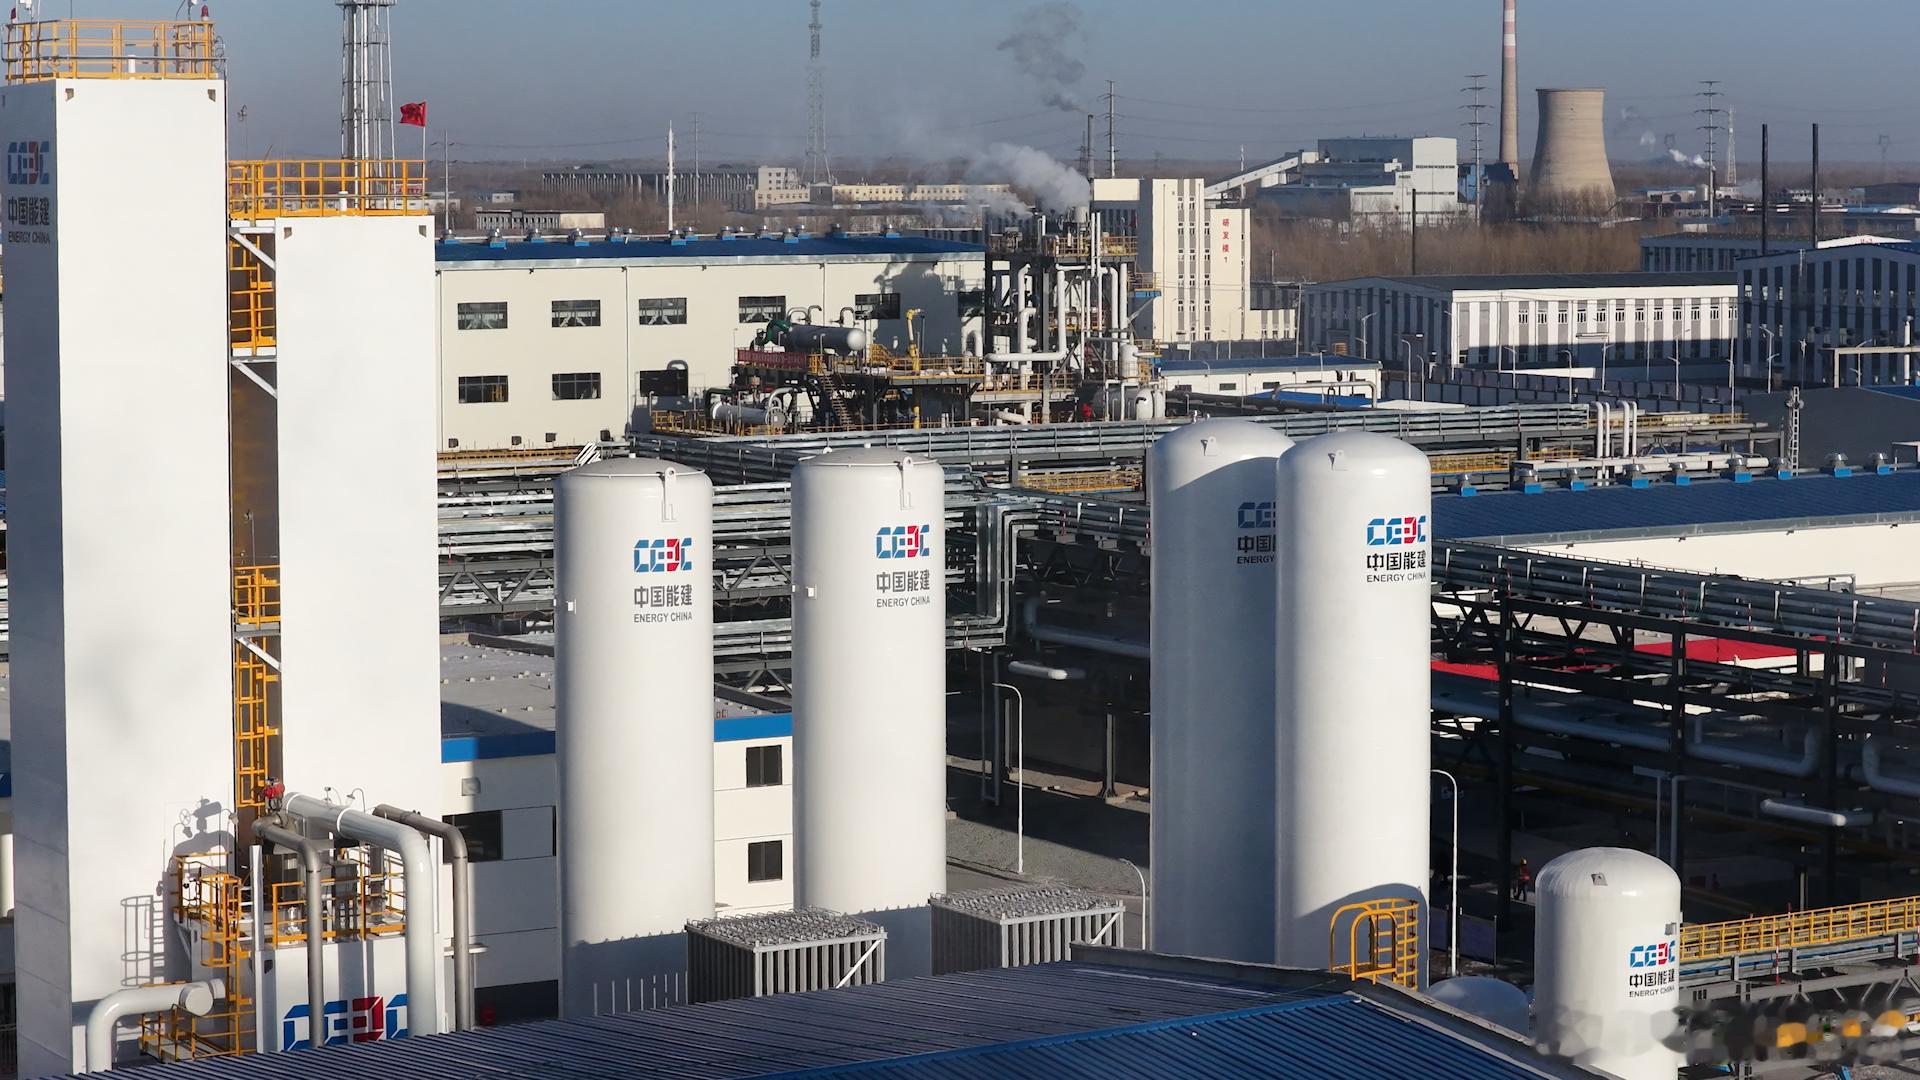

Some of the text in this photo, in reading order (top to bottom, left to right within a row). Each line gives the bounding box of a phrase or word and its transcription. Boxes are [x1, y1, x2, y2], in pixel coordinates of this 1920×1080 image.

[8, 196, 50, 226] 中国能建
[8, 231, 50, 244] ENERGY CHINA
[1237, 555, 1275, 564] ENERGY
[1367, 550, 1426, 571] 中国能建
[877, 569, 930, 593] 中国能建
[1366, 572, 1426, 582] ENERGY CHINA
[634, 584, 692, 608] 中国能建
[877, 596, 930, 608] ENERGY CHINA
[634, 611, 692, 623] ENERGY CHINA
[1629, 969, 1675, 988] 中国能建
[1629, 988, 1659, 998] ENERGY
